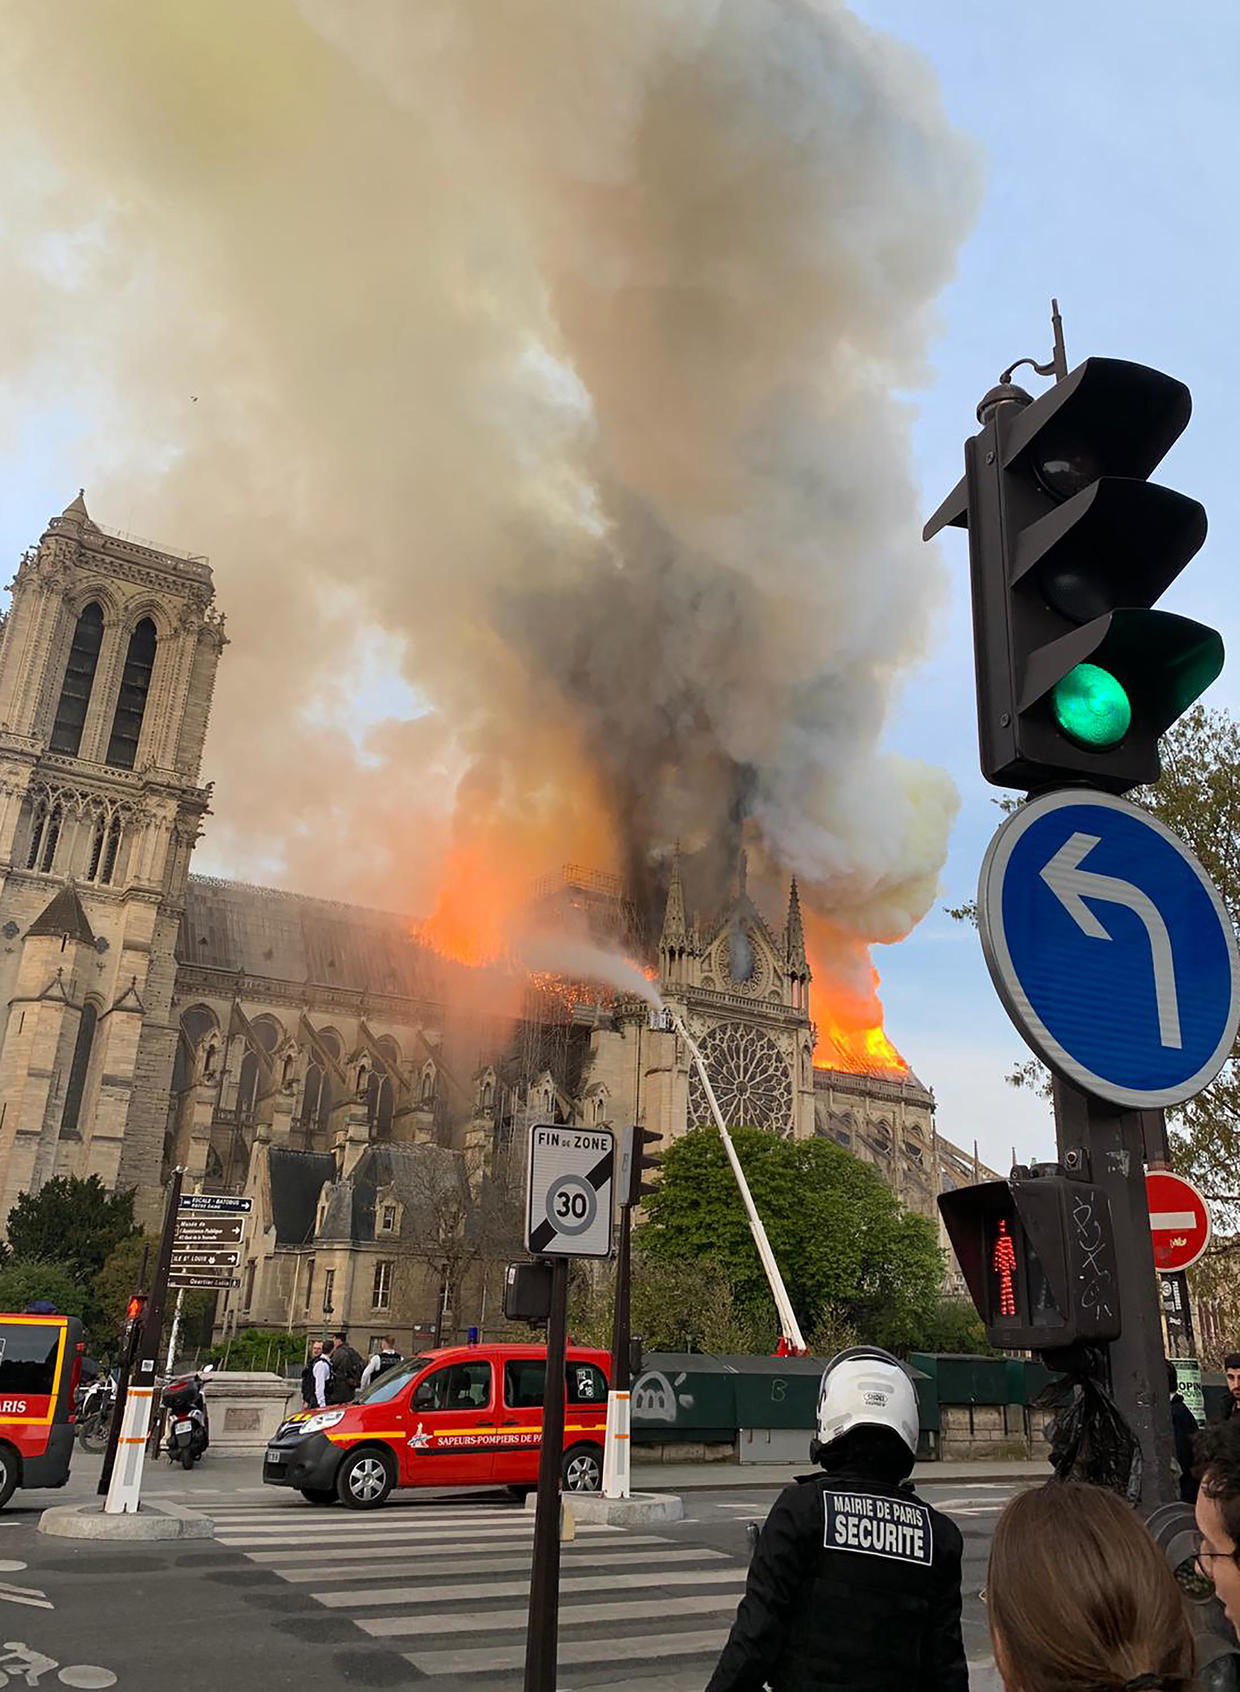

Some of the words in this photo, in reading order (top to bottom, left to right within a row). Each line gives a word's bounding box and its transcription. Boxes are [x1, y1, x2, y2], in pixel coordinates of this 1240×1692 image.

[538, 1132, 560, 1145] FIN
[574, 1136, 608, 1151] ZONE
[556, 1191, 587, 1219] 30
[437, 1434, 520, 1446] SAPEURS-POMPIERS
[520, 1434, 531, 1443] DE
[833, 1495, 874, 1517] MAIRIE
[876, 1500, 891, 1520] DE
[892, 1504, 923, 1527] PARIS
[834, 1514, 924, 1558] SECURITE
